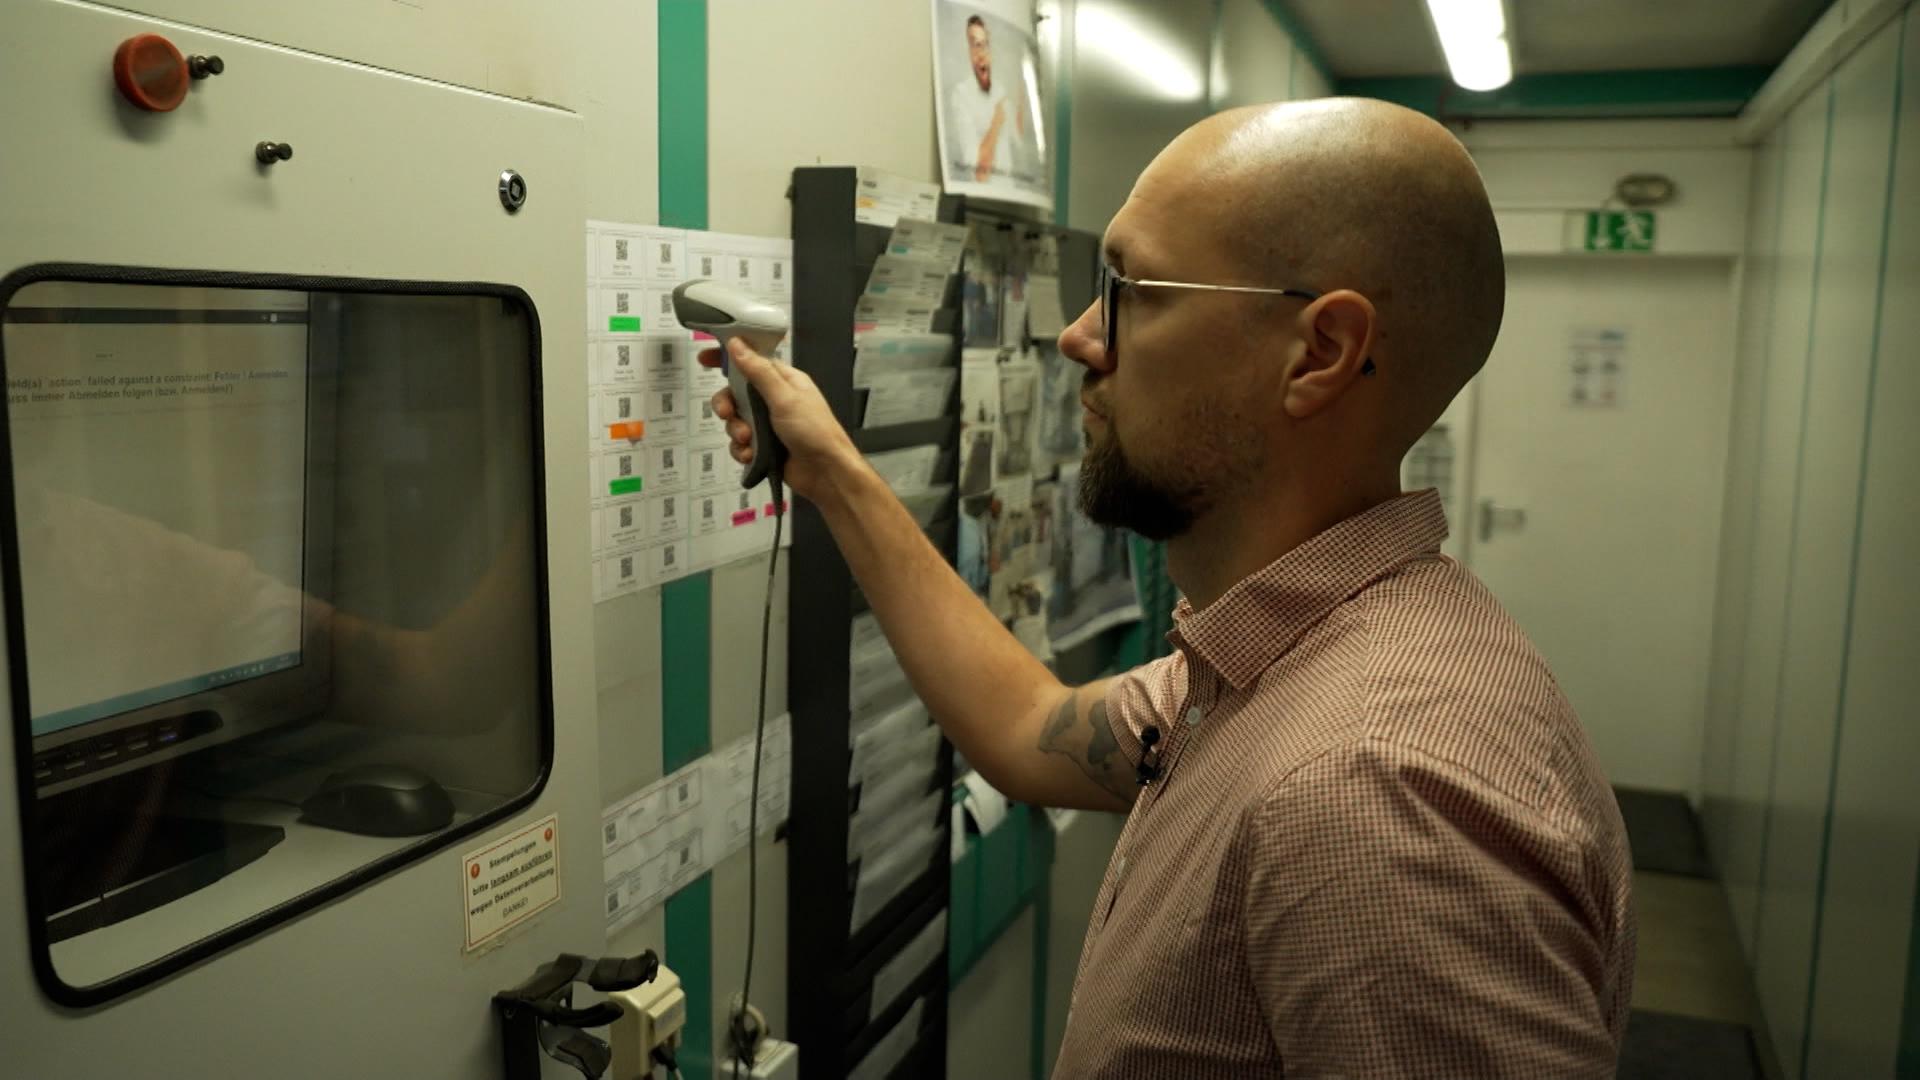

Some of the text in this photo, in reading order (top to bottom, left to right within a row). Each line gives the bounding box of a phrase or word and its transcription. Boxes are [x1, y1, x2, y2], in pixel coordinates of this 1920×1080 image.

[87, 375, 116, 386] failed
[119, 375, 153, 387] against
[155, 375, 162, 384] a
[32, 391, 65, 402] immer
[68, 389, 120, 401] Abmelden
[122, 386, 153, 401] folgen
[489, 841, 536, 868] Stempelungen
[472, 850, 553, 896] bitte langsam ausführen
[470, 867, 554, 916] wegen Datenverarbeitung
[502, 897, 528, 917] DANKE!
